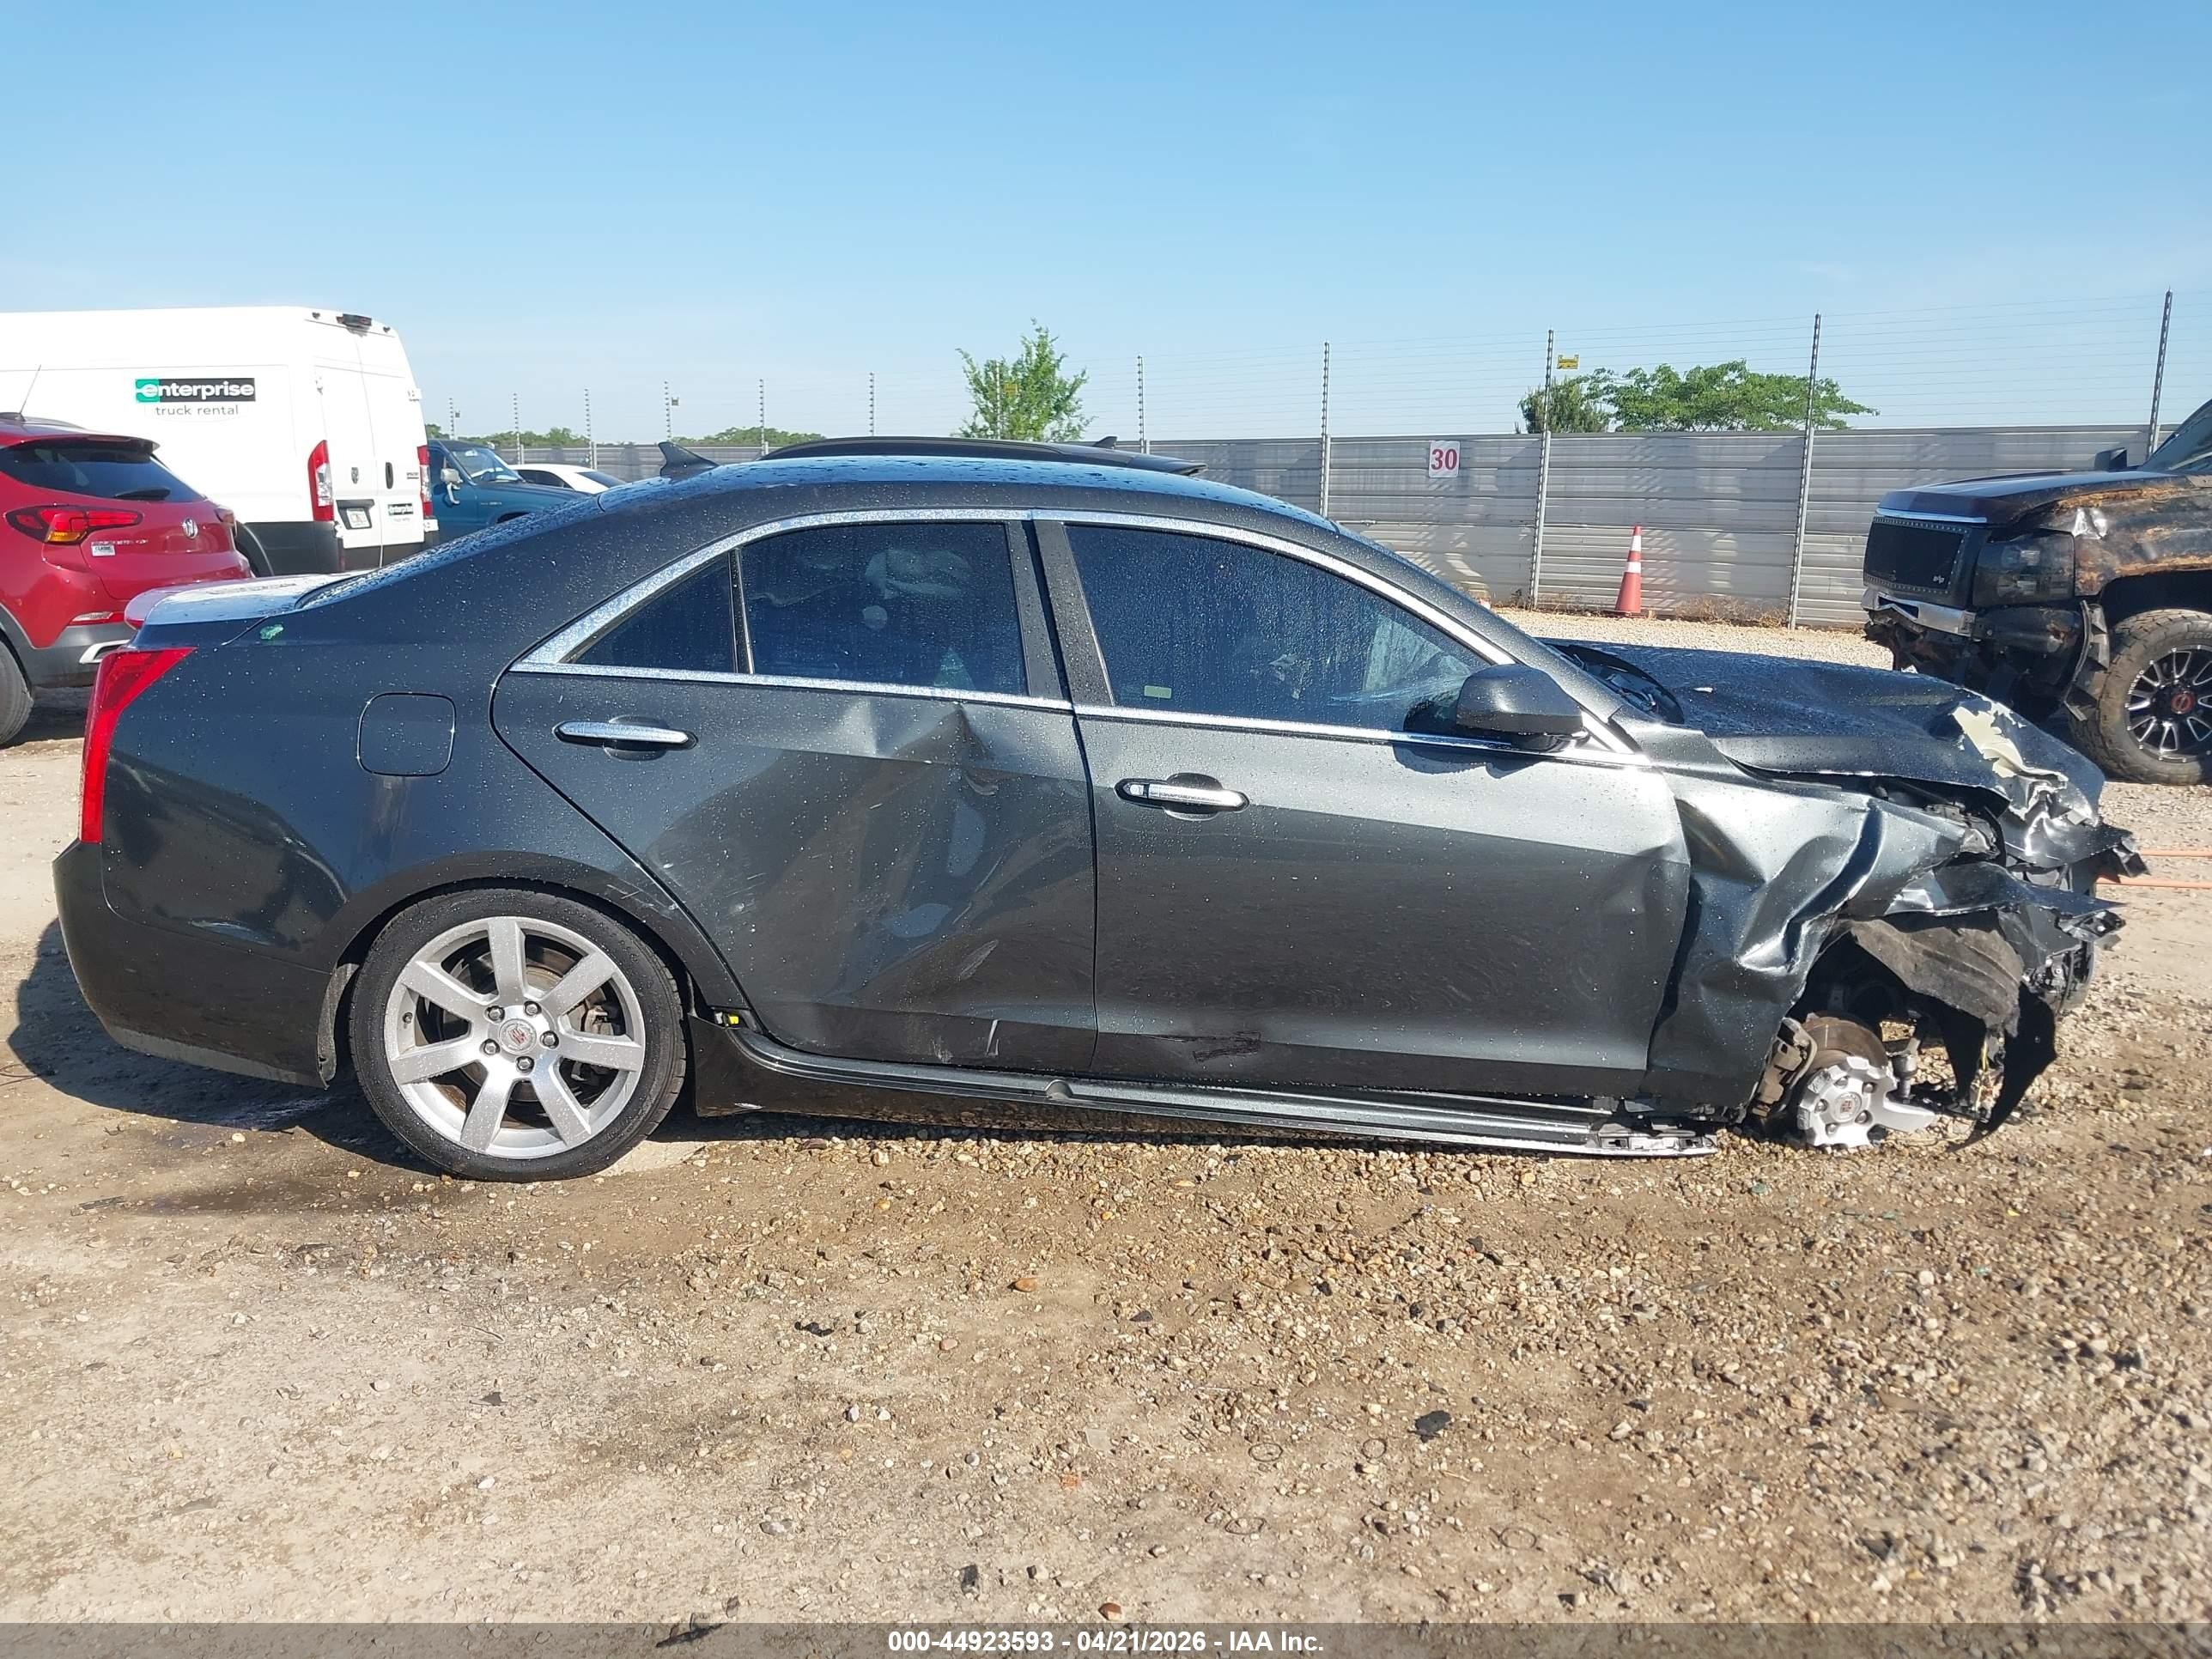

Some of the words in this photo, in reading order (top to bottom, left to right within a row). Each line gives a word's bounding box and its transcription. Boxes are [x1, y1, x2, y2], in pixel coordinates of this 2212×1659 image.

[138, 380, 255, 400] enterprise
[155, 404, 192, 416] truck
[198, 404, 239, 416] rental
[1431, 448, 1458, 471] 30
